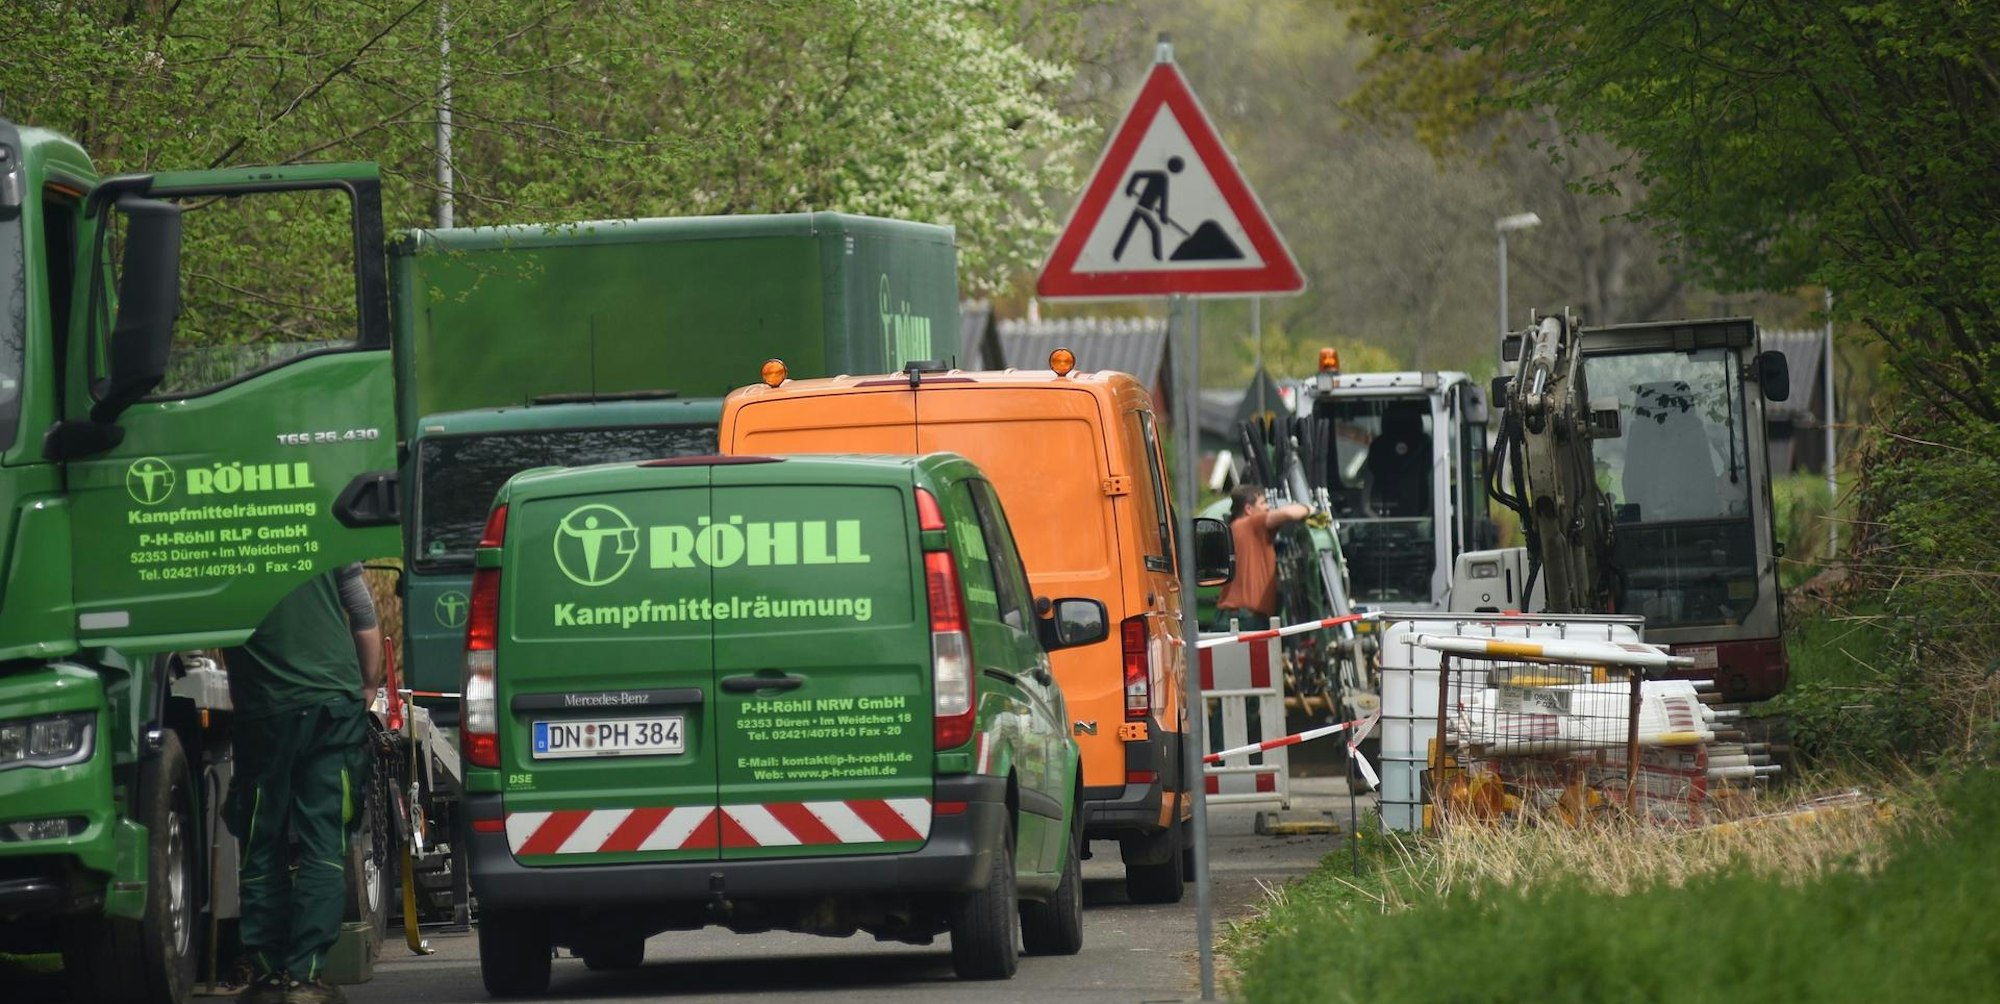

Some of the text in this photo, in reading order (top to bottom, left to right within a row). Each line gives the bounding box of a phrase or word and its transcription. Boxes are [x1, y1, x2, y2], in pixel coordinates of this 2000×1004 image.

[277, 428, 379, 446] TGS 26.430
[186, 462, 315, 495] RÖHLL
[128, 502, 316, 525] Kampfmittelräumung
[140, 524, 308, 547] P-H-Röhll RLP GmbH
[650, 515, 871, 569] RÖHLL
[130, 541, 318, 563] 52353 Düren Im Weidchen 18
[139, 559, 312, 581] Tel. 02421/40781-0 Fax -20
[554, 596, 872, 628] Kampfmittelräumung
[564, 692, 649, 707] Mercedes-Benz
[741, 696, 906, 714] P-H-Röhll NRW GmbH
[737, 713, 912, 729] 52353 Düren Im Weidchen 18
[549, 721, 679, 749] DN PH 384
[748, 725, 902, 741] Tel. 02421/40781-0 Fax -20
[738, 752, 913, 768] E-Mail: kontakt@p-h-roehll.de
[509, 773, 533, 784] DSE
[754, 766, 898, 780] Web: www.p-h-roehll.de
